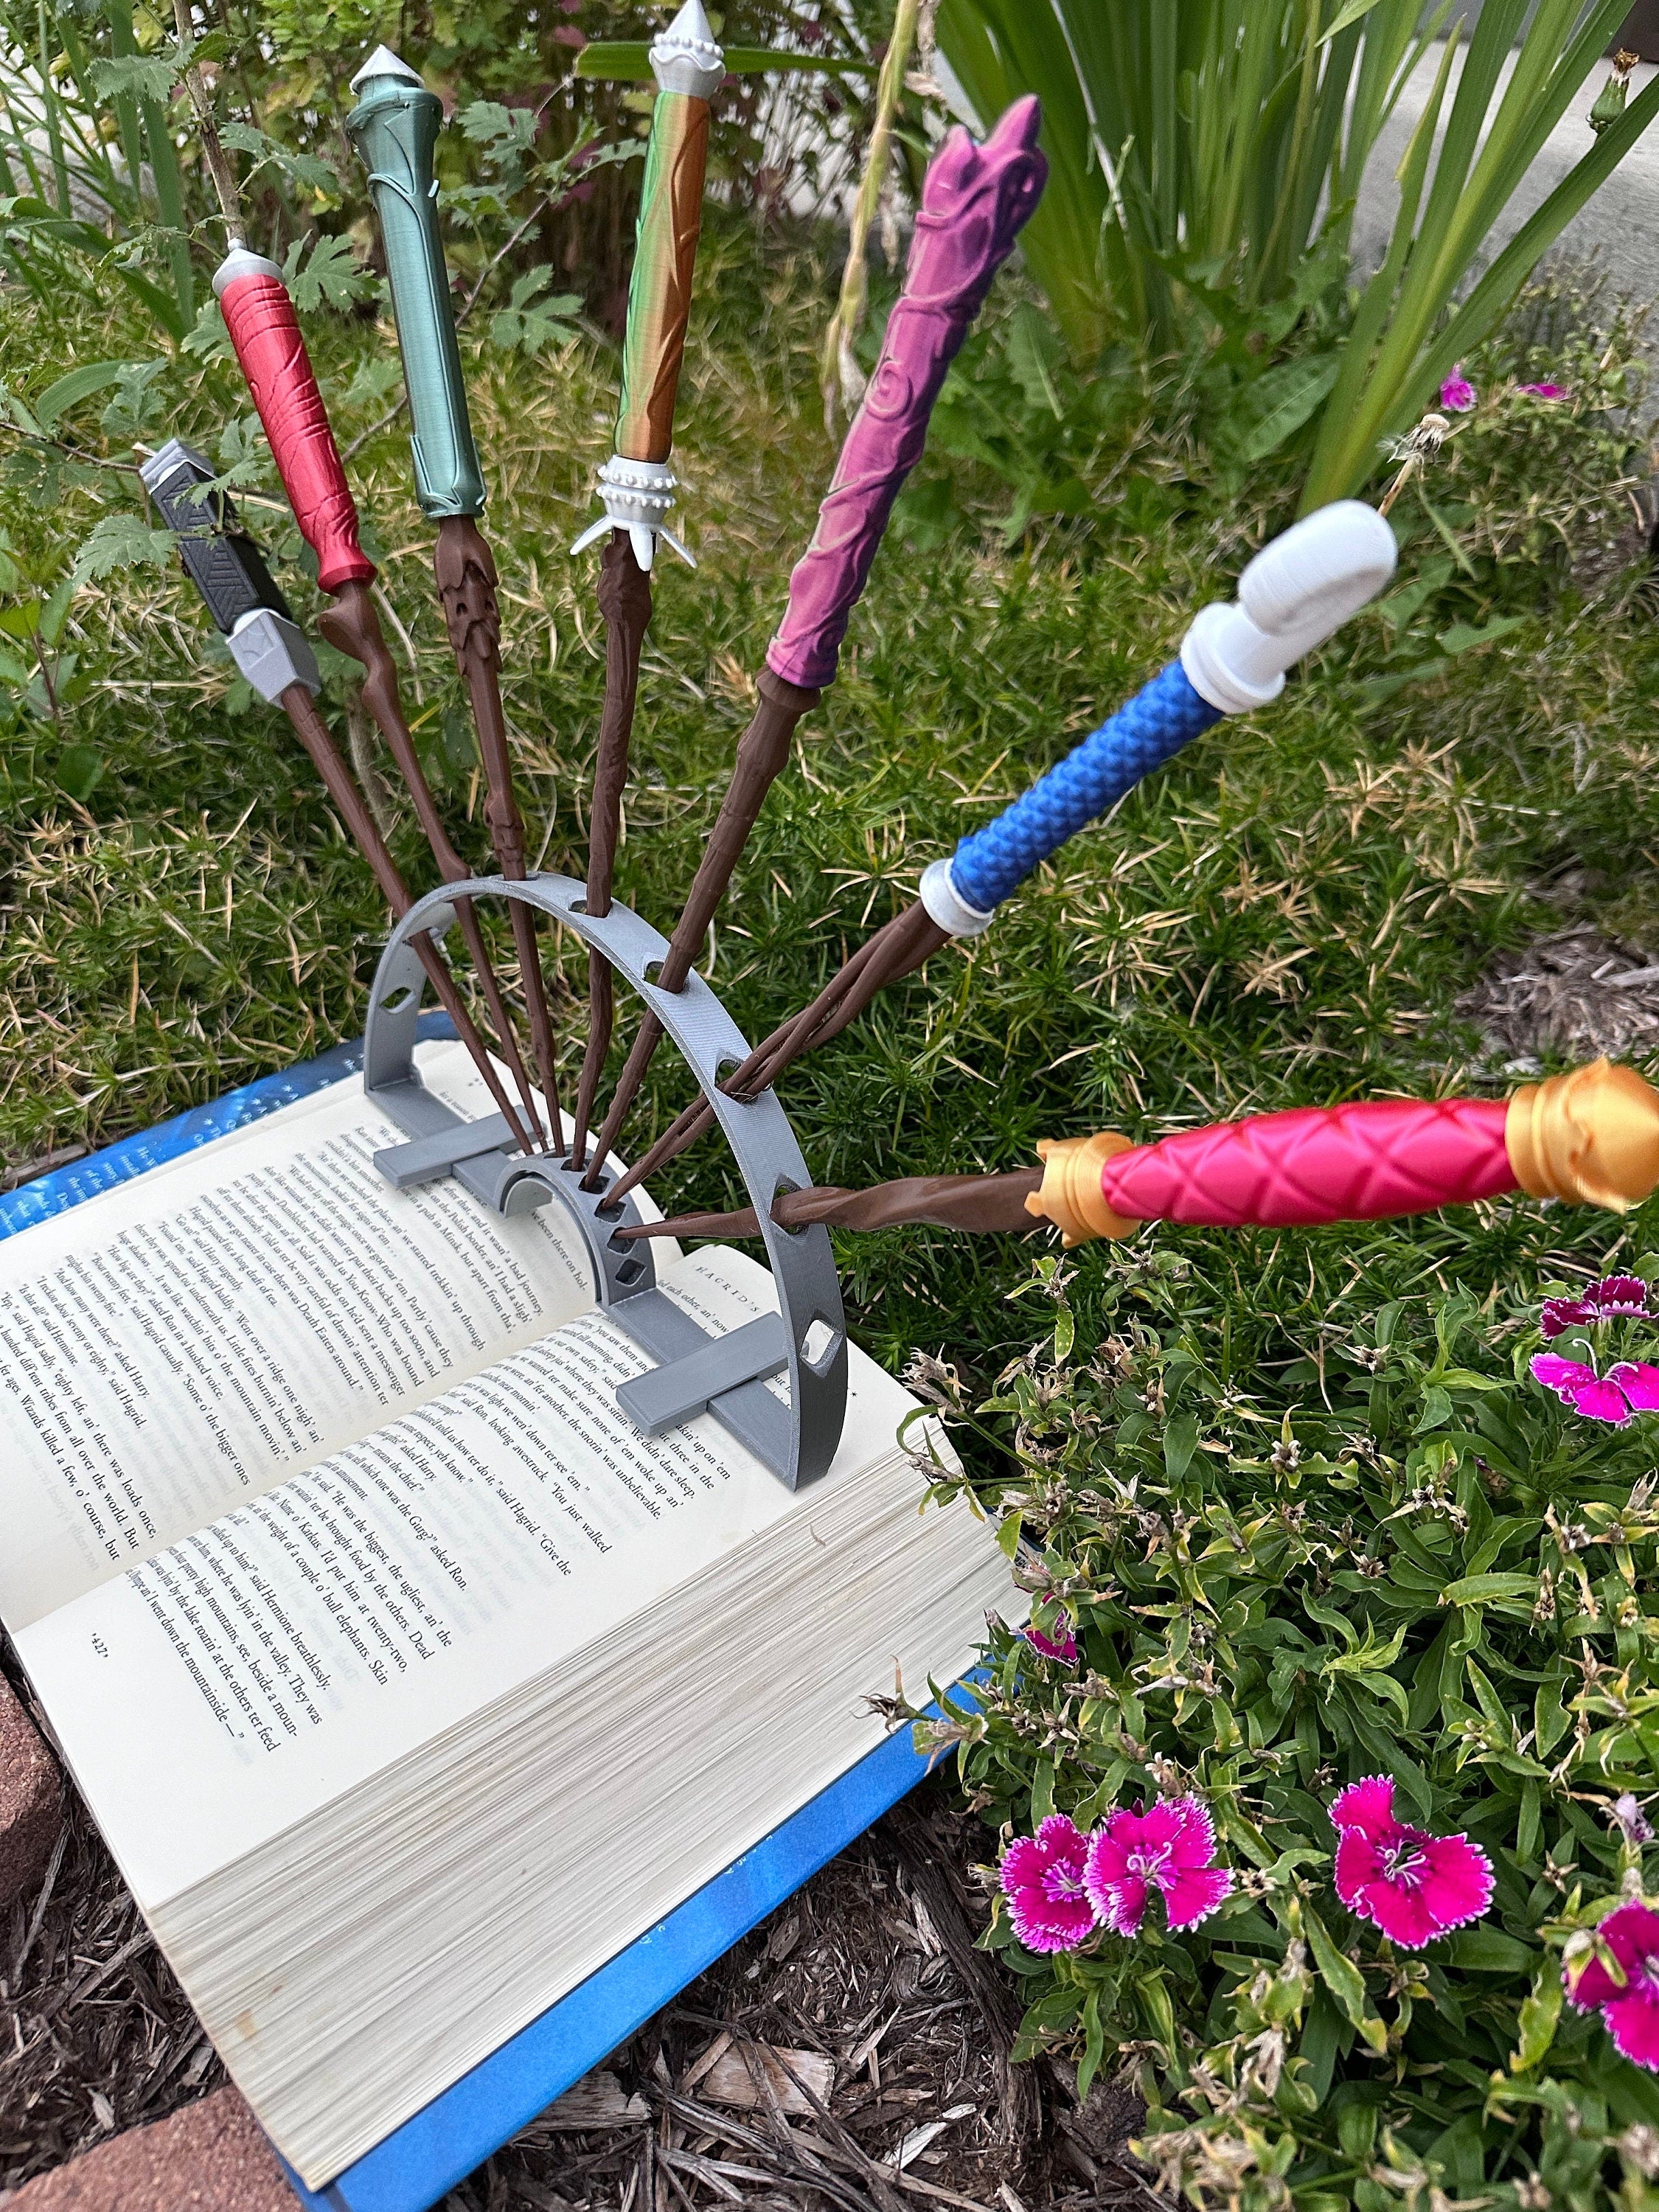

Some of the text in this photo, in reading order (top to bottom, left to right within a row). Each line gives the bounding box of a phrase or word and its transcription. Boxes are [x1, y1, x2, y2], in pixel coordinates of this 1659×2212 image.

[508, 1262, 544, 1317] bad journey.
[551, 1238, 588, 1291] there on hol-
[666, 1285, 684, 1296] each
[681, 1294, 701, 1310] other,
[712, 1318, 730, 1333] now
[114, 1351, 150, 1399] asked Harry.
[147, 1298, 170, 1317] asked
[161, 1314, 178, 1332] Ron
[173, 1329, 184, 1341] in
[184, 1343, 212, 1375] hushed
[205, 1374, 223, 1401] voice.
[296, 1302, 321, 1329] Death
[314, 1326, 336, 1354] Eaters
[345, 1273, 425, 1388] You-Know-Who was bound
[352, 1349, 389, 1406] attention ter
[358, 1324, 406, 1396] sent a messenger
[406, 1295, 427, 1321] Partly
[438, 1347, 454, 1368] they
[108, 1378, 147, 1429] said Hagrid.
[220, 1361, 262, 1422] the mountain
[226, 1334, 246, 1358] Little
[240, 1356, 257, 1377] fires
[274, 1408, 296, 1439] below
[563, 1364, 585, 1382] where
[581, 1380, 599, 1396] they
[596, 1394, 611, 1408] was
[630, 1426, 645, 1442] We
[658, 1459, 678, 1478] dare
[674, 1476, 695, 1500] sleep.
[20, 1394, 46, 1429] Wizards
[40, 1428, 64, 1456] killed
[56, 1457, 66, 1465] a
[61, 1465, 78, 1488] few,
[83, 1502, 106, 1540] course,
[105, 1538, 120, 1561] but
[39, 1388, 140, 1550] tribes from all over the world. But
[93, 1432, 157, 1539] there was loads once,
[205, 1413, 251, 1486] the bigger ones
[487, 1417, 515, 1447] looking
[512, 1446, 549, 1483] awestruck.
[562, 1503, 583, 1523] just
[582, 1522, 613, 1554] walked
[541, 1394, 570, 1420] another,
[567, 1418, 582, 1432] the
[602, 1454, 619, 1470] was
[615, 1470, 661, 1520] unbelievable.
[591, 1416, 611, 1436] none
[609, 1435, 626, 1445] of
[634, 1460, 656, 1483] woke
[654, 1482, 668, 1495] up
[669, 1442, 715, 1489] three in the
[692, 1441, 706, 1453] up
[703, 1452, 717, 1465] on
[352, 1519, 367, 1534] the
[364, 1531, 390, 1565] biggest,
[387, 1564, 403, 1580] the
[400, 1580, 425, 1613] ugliest,
[436, 1630, 452, 1647] the
[375, 1478, 390, 1492] one
[386, 1489, 402, 1505] was
[397, 1503, 412, 1517] the
[430, 1545, 456, 1570] asked
[448, 1566, 467, 1592] Ron.
[495, 1488, 518, 1506] said
[509, 1502, 541, 1536] Hagrid.
[556, 1559, 572, 1576] the
[248, 1574, 331, 1691] said Hermione breathlessly.
[295, 1557, 321, 1585] couple
[322, 1591, 344, 1614] bull
[335, 1614, 370, 1660] elephants.
[368, 1659, 389, 1686] Skin
[325, 1518, 436, 1660] brought food by the others. Dead
[326, 1565, 408, 1673] put him at twenty-two,
[160, 1618, 229, 1722] down the mountainside
[183, 1605, 201, 1626] lake
[212, 1653, 224, 1665] at
[218, 1663, 234, 1681] the
[229, 1680, 253, 1712] others
[248, 1711, 263, 1728] ter
[257, 1726, 282, 1753] feed
[194, 1577, 297, 1736] high mountains, see, beside a moun-
[220, 1573, 234, 1587] he
[229, 1585, 244, 1602] was
[251, 1618, 264, 1632] in
[258, 1631, 274, 1648] the
[269, 1646, 292, 1677] valley.
[288, 1673, 310, 1703] They
[305, 1703, 323, 1725] was
